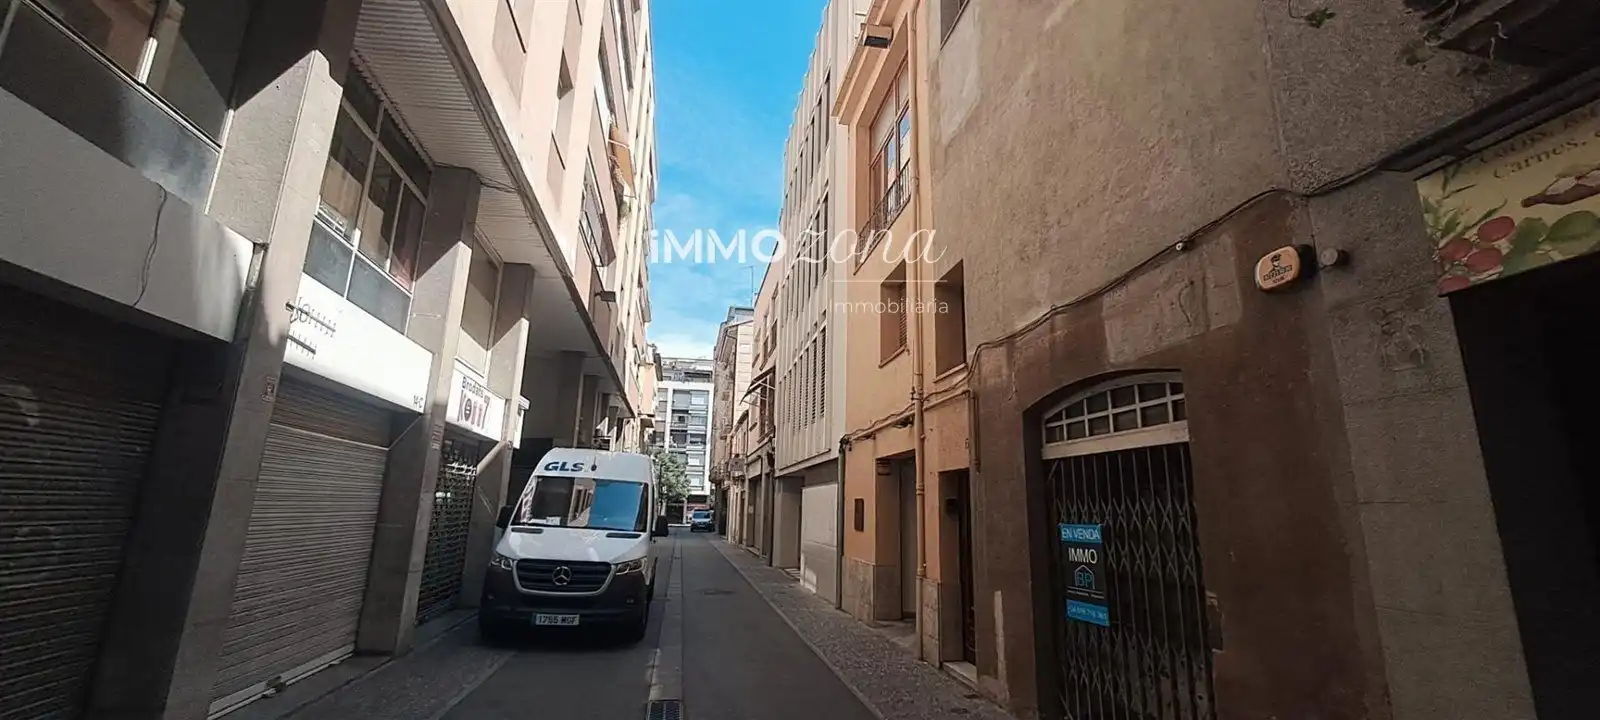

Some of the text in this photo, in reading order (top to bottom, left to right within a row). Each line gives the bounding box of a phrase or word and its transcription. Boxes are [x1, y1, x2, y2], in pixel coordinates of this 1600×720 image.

[544, 461, 585, 472] GLS
[1062, 528, 1100, 540] EN VENDA
[1068, 547, 1098, 564] IMMO
